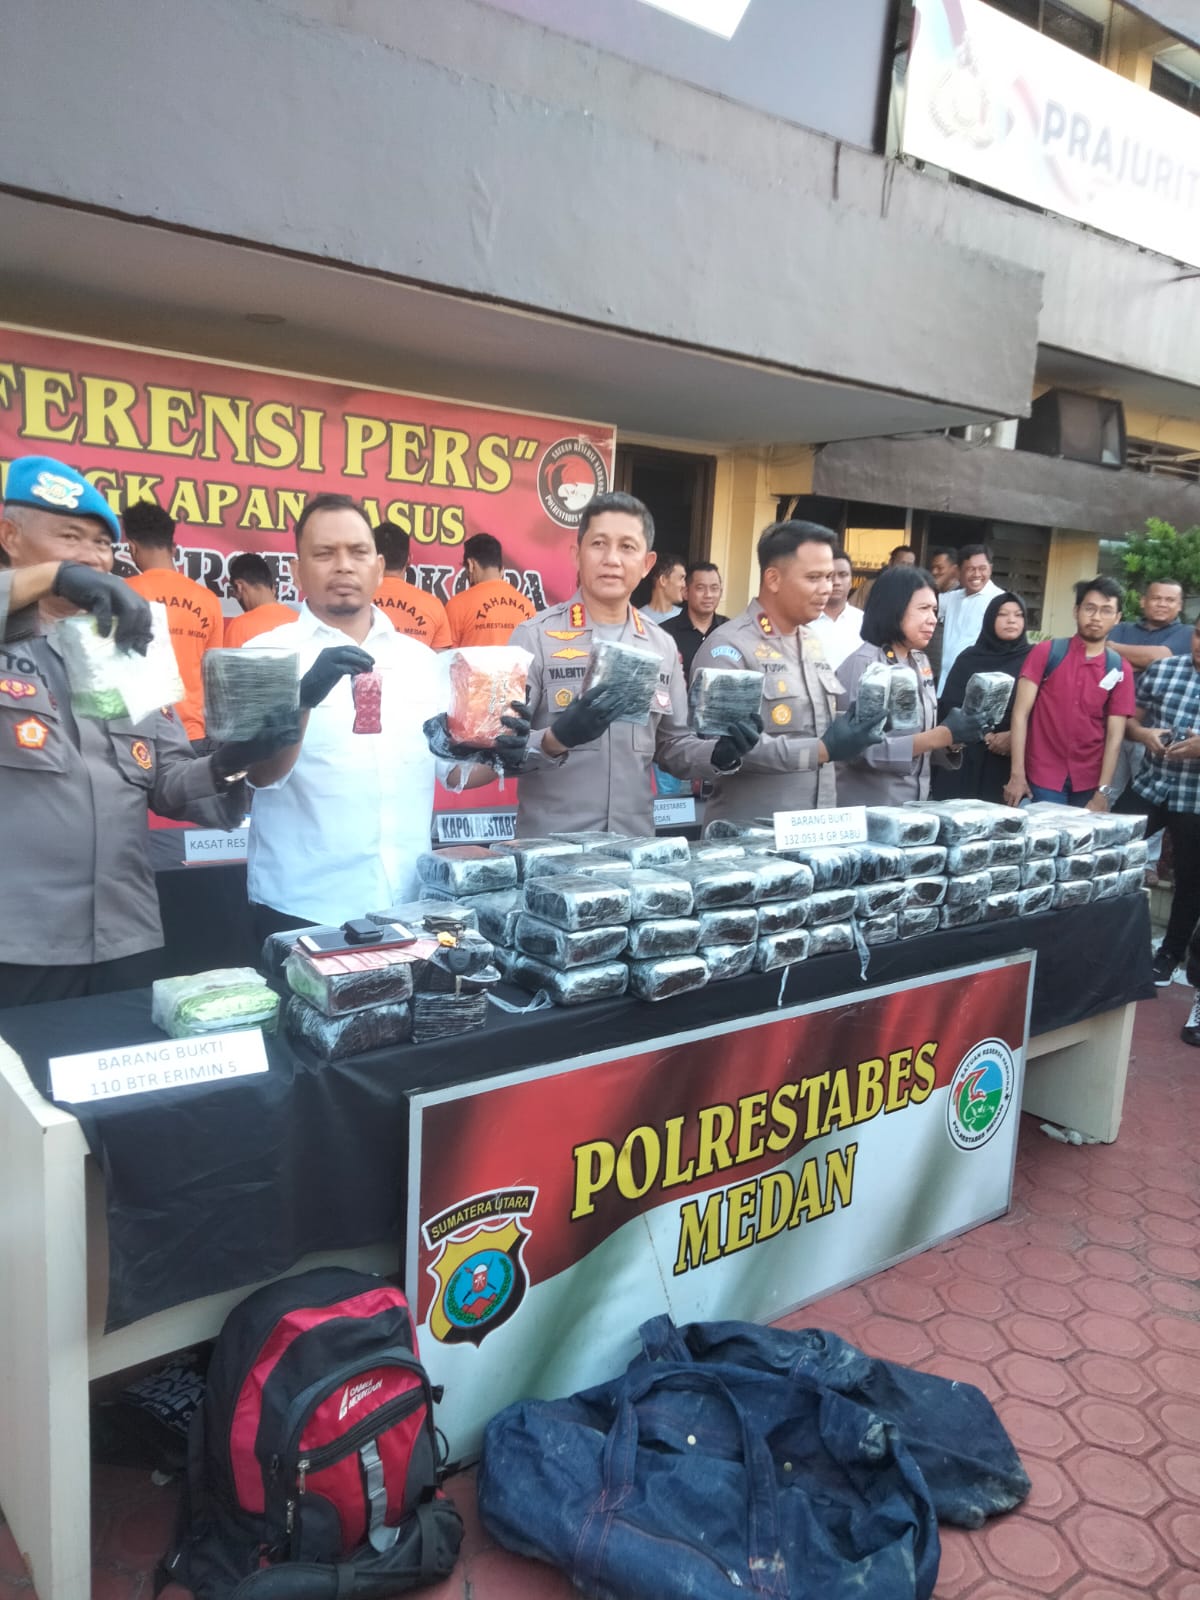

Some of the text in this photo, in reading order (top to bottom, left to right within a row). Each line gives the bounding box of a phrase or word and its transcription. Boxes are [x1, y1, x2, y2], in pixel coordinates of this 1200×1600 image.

[360, 498, 467, 546] ASUS
[155, 596, 209, 629] HANAN
[373, 597, 426, 627] HANAN
[190, 839, 224, 850] KASAT
[98, 1041, 224, 1071] BARANG BUKTI
[90, 1079, 121, 1096] 110
[127, 1072, 158, 1090] BTR
[164, 1063, 224, 1084] ERIMIN
[570, 1040, 939, 1220] POLRESTABES
[431, 1196, 529, 1239] SUMATERA UTARA
[673, 1143, 859, 1277] MEDAN
